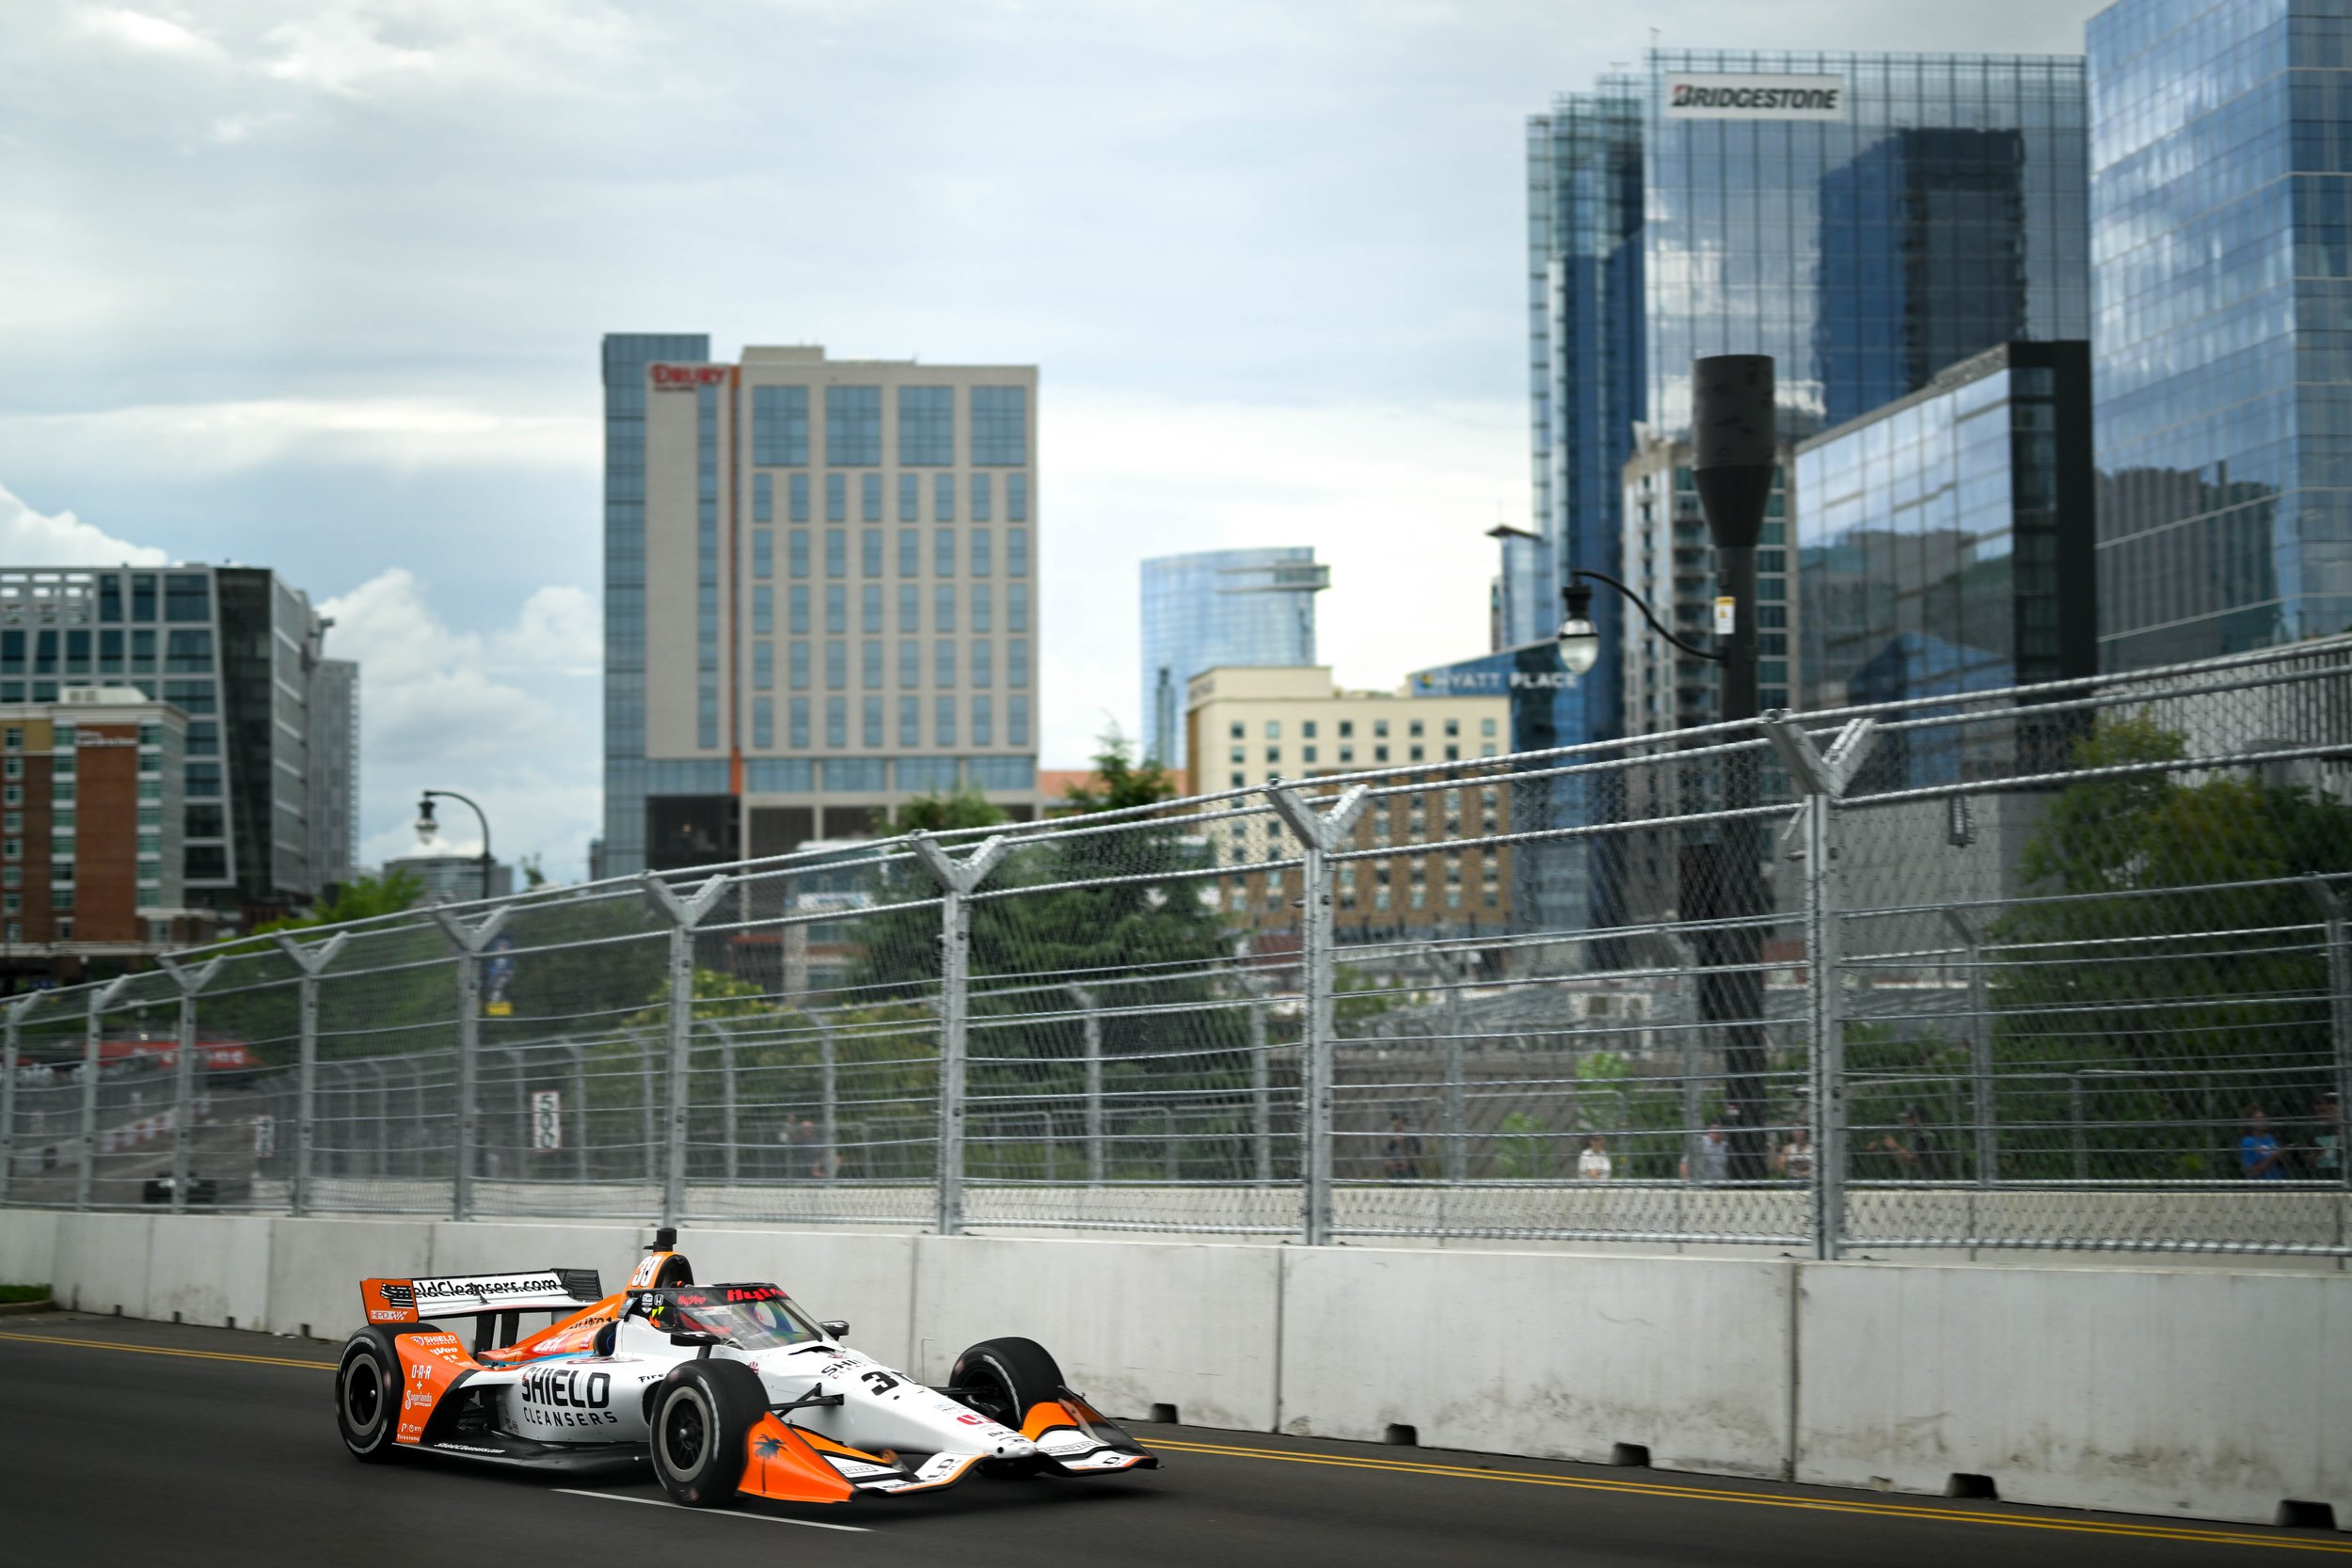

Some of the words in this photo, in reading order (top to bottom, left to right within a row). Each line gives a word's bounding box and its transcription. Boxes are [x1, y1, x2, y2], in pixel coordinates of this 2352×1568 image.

[1672, 84, 1838, 109] BRIDGESTONE
[653, 364, 723, 384] DRURY
[1435, 673, 1501, 688] HYATT
[1509, 673, 1578, 689] PLACE
[538, 1094, 555, 1148] 500
[631, 1255, 662, 1288] 30
[423, 1335, 456, 1343] SHIELD
[521, 1366, 612, 1409] SHIELD
[523, 1406, 619, 1428] CLEANSERS
[396, 1433, 421, 1442] Firestone
